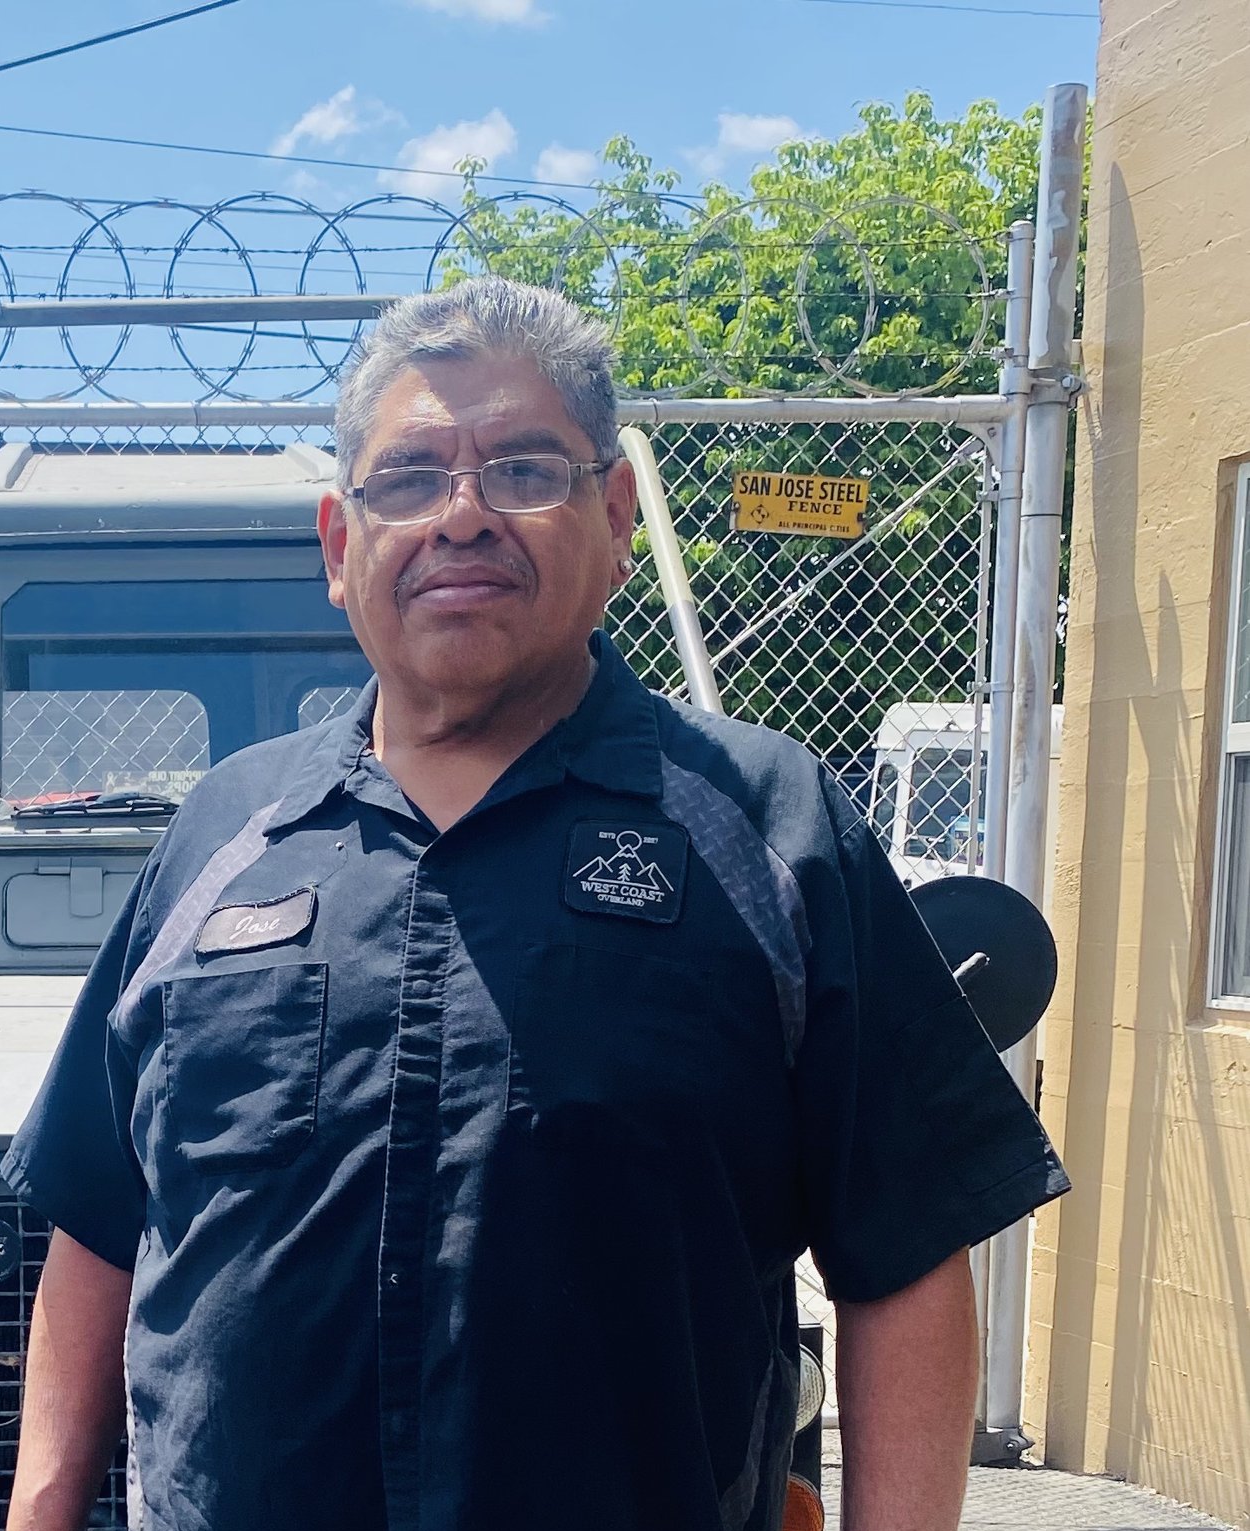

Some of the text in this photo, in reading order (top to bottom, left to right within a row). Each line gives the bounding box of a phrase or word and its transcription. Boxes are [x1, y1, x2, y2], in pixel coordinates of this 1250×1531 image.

[739, 475, 864, 503] SAN JOSE STEEL
[788, 500, 843, 515] FENCE
[792, 522, 827, 531] PRINCIPAL
[830, 525, 850, 533] CITIES
[580, 880, 665, 902] WEST COAST
[597, 893, 645, 907] OVERLAND
[229, 915, 280, 940] Jose
